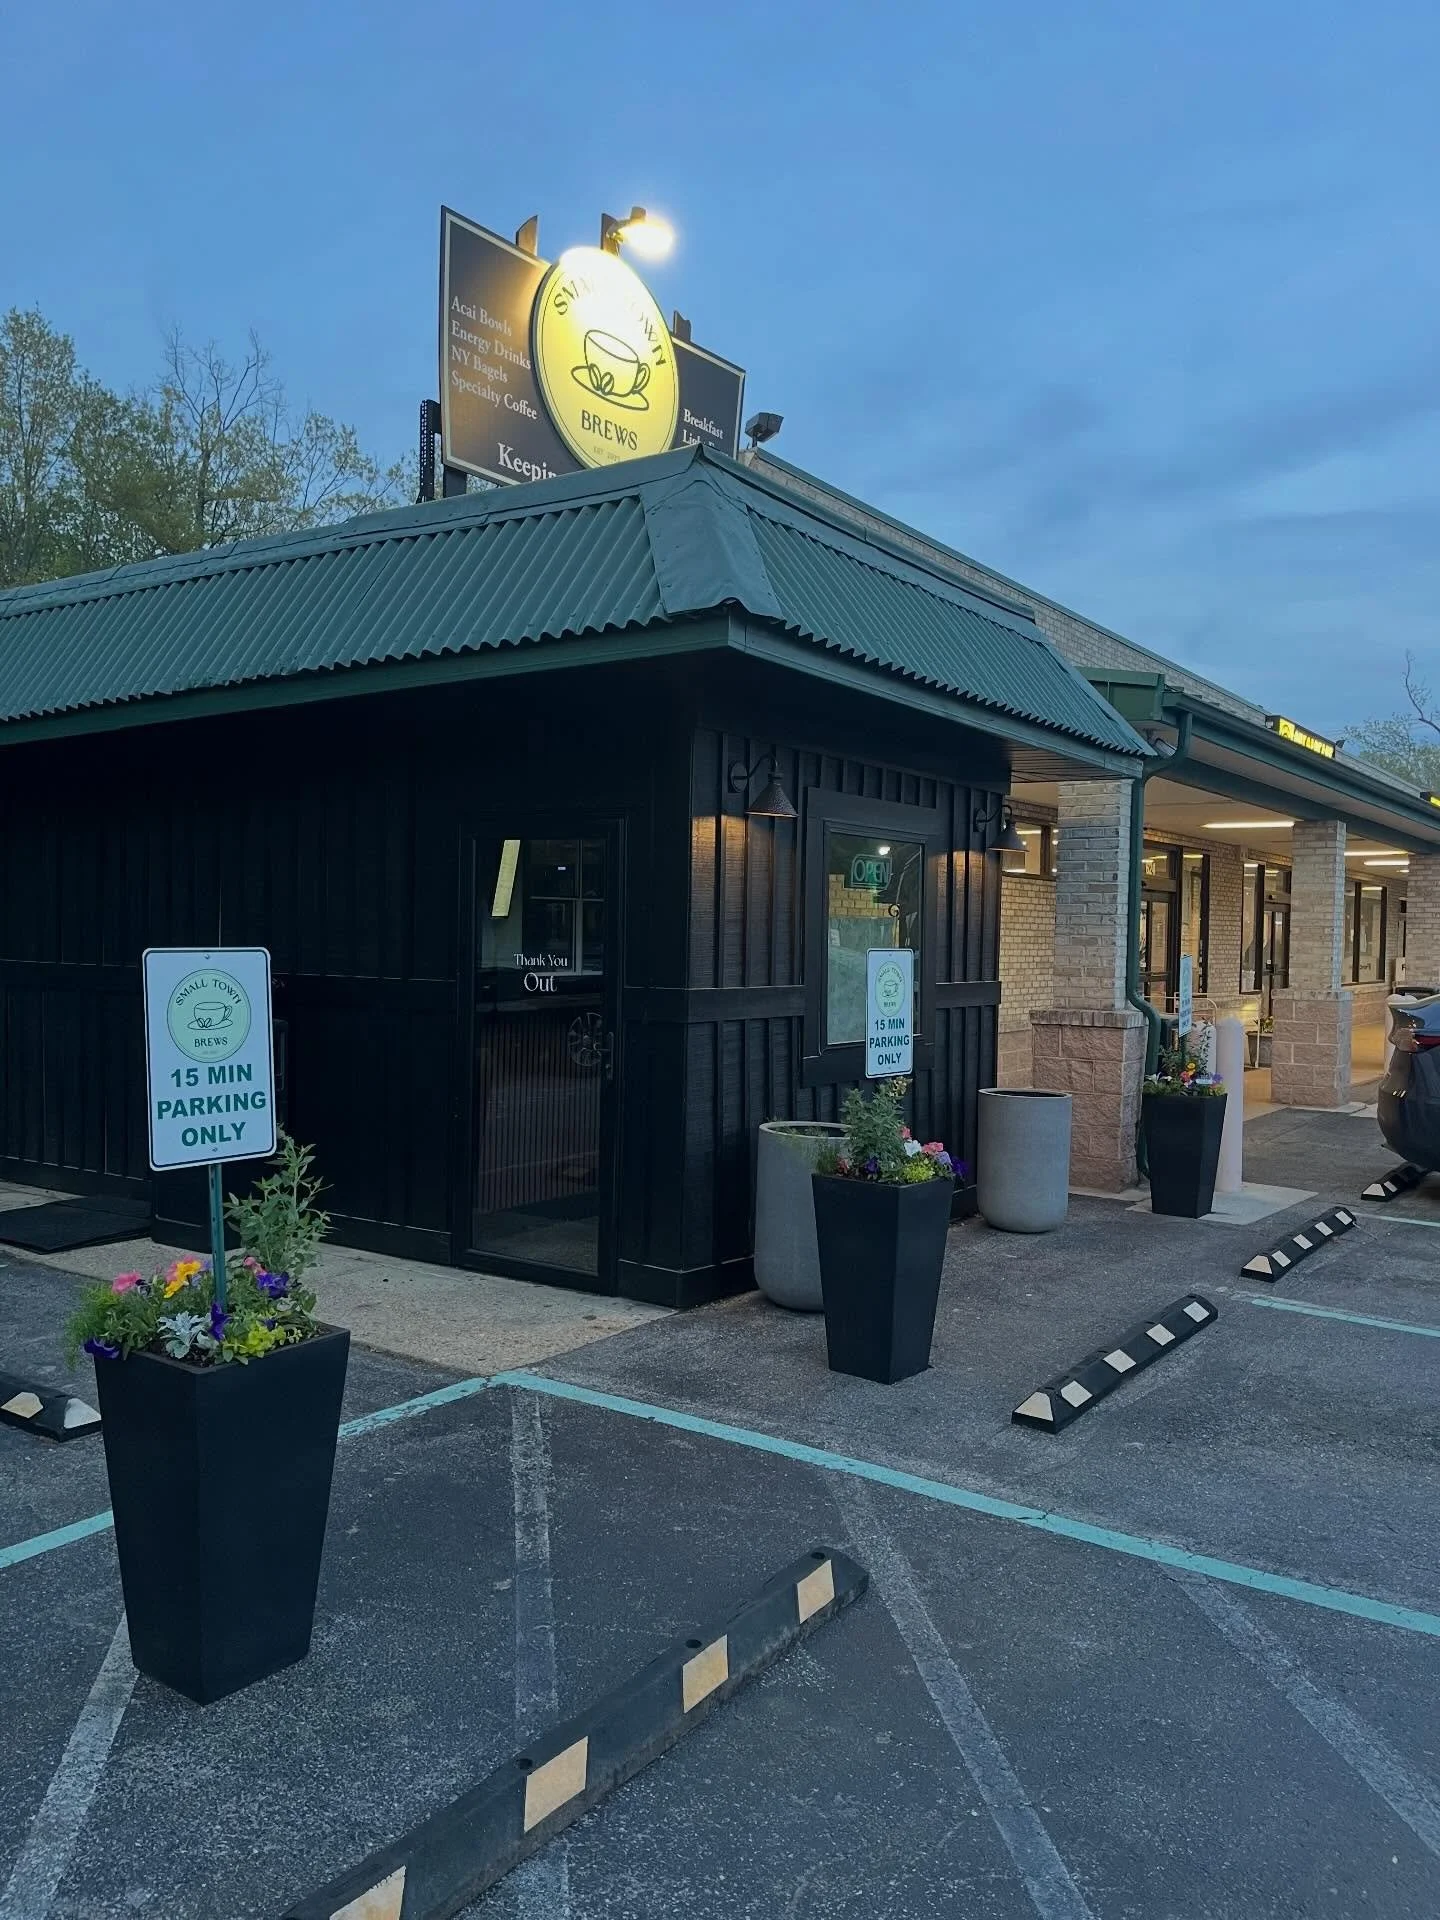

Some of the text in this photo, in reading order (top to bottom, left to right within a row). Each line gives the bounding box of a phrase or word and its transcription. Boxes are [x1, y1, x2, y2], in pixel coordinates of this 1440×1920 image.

[451, 295, 512, 337] Acai Bowls
[451, 320, 531, 370] Energy Drinks
[451, 345, 508, 383] NY Bagels
[451, 370, 538, 420] Specialty Coffee
[581, 409, 638, 451] BREWS
[683, 408, 724, 440] Breakfast
[496, 442, 557, 482] Keepin
[854, 859, 890, 884] OPEN
[513, 953, 568, 967] Thank You
[176, 978, 242, 1006] SMALL TOWN
[523, 972, 558, 992] Out
[874, 1018, 905, 1031] 15 MIN
[194, 1036, 228, 1048] BREWS
[869, 1034, 910, 1049] PARKING
[877, 1052, 902, 1066] ONLY
[170, 1063, 252, 1088] 15 MIN
[157, 1091, 266, 1120] PARKING
[181, 1121, 246, 1147] ONLY
